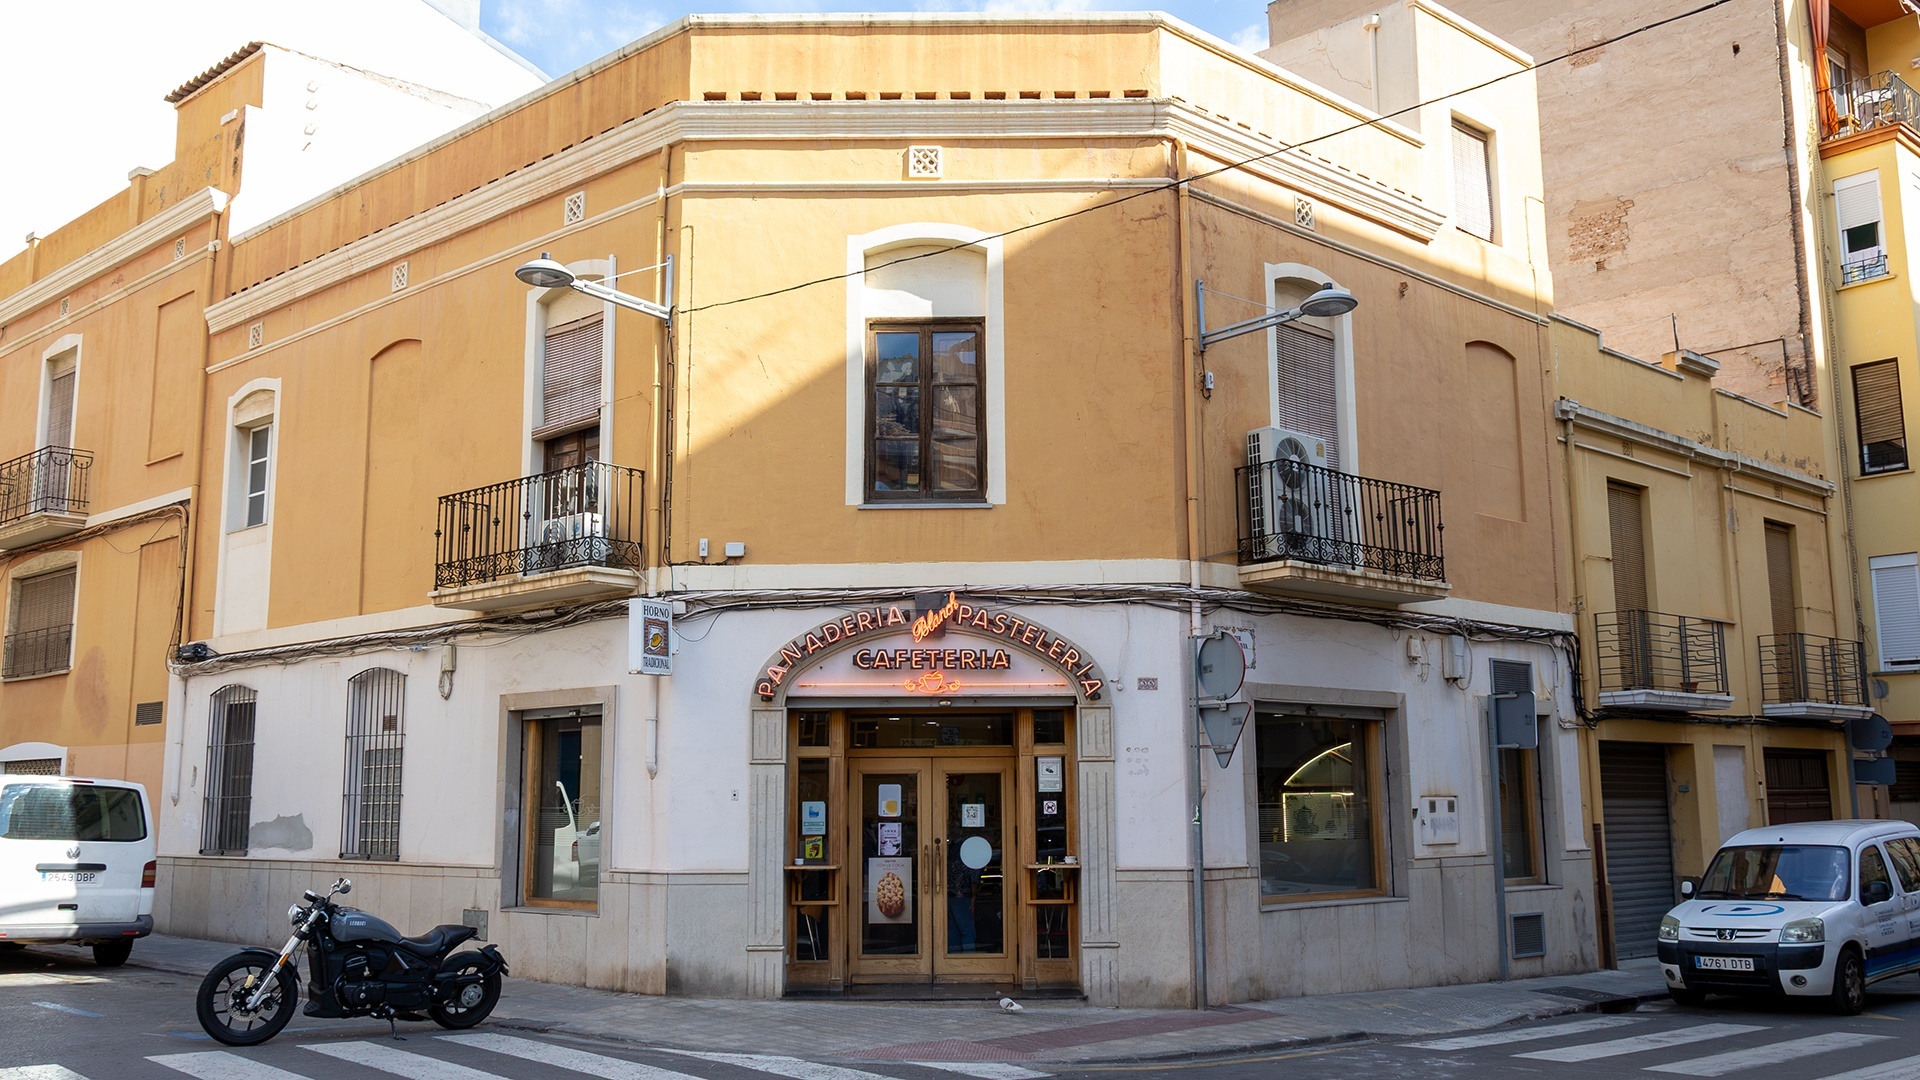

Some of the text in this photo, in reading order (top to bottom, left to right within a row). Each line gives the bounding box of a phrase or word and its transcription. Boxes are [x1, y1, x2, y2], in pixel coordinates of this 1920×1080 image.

[643, 605, 670, 619] HORNO
[756, 604, 909, 698] PANADERIA
[854, 649, 1010, 669] CAFETERIA
[956, 604, 1103, 699] PASTELERIA
[76, 873, 96, 882] DBP
[1702, 958, 1752, 970] 4761 DTB
